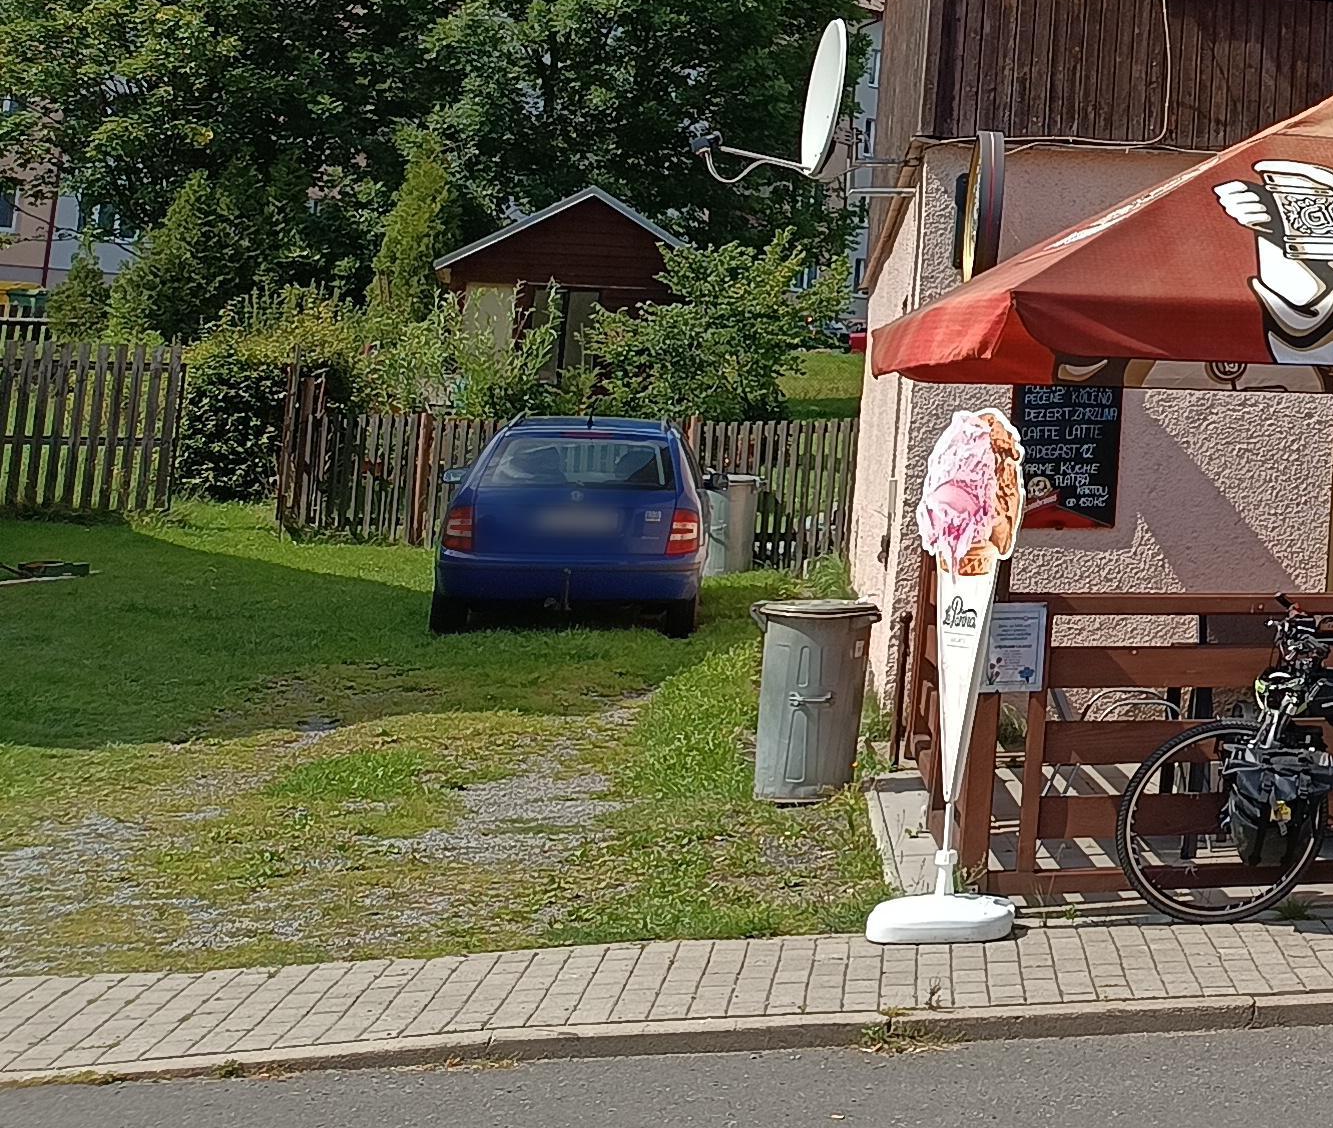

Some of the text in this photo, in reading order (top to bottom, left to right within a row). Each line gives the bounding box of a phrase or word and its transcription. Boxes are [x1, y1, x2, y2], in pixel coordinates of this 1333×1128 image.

[1025, 408, 1072, 421] DEZERT
[1066, 425, 1103, 439] LATTE
[1023, 463, 1056, 474] ARME
